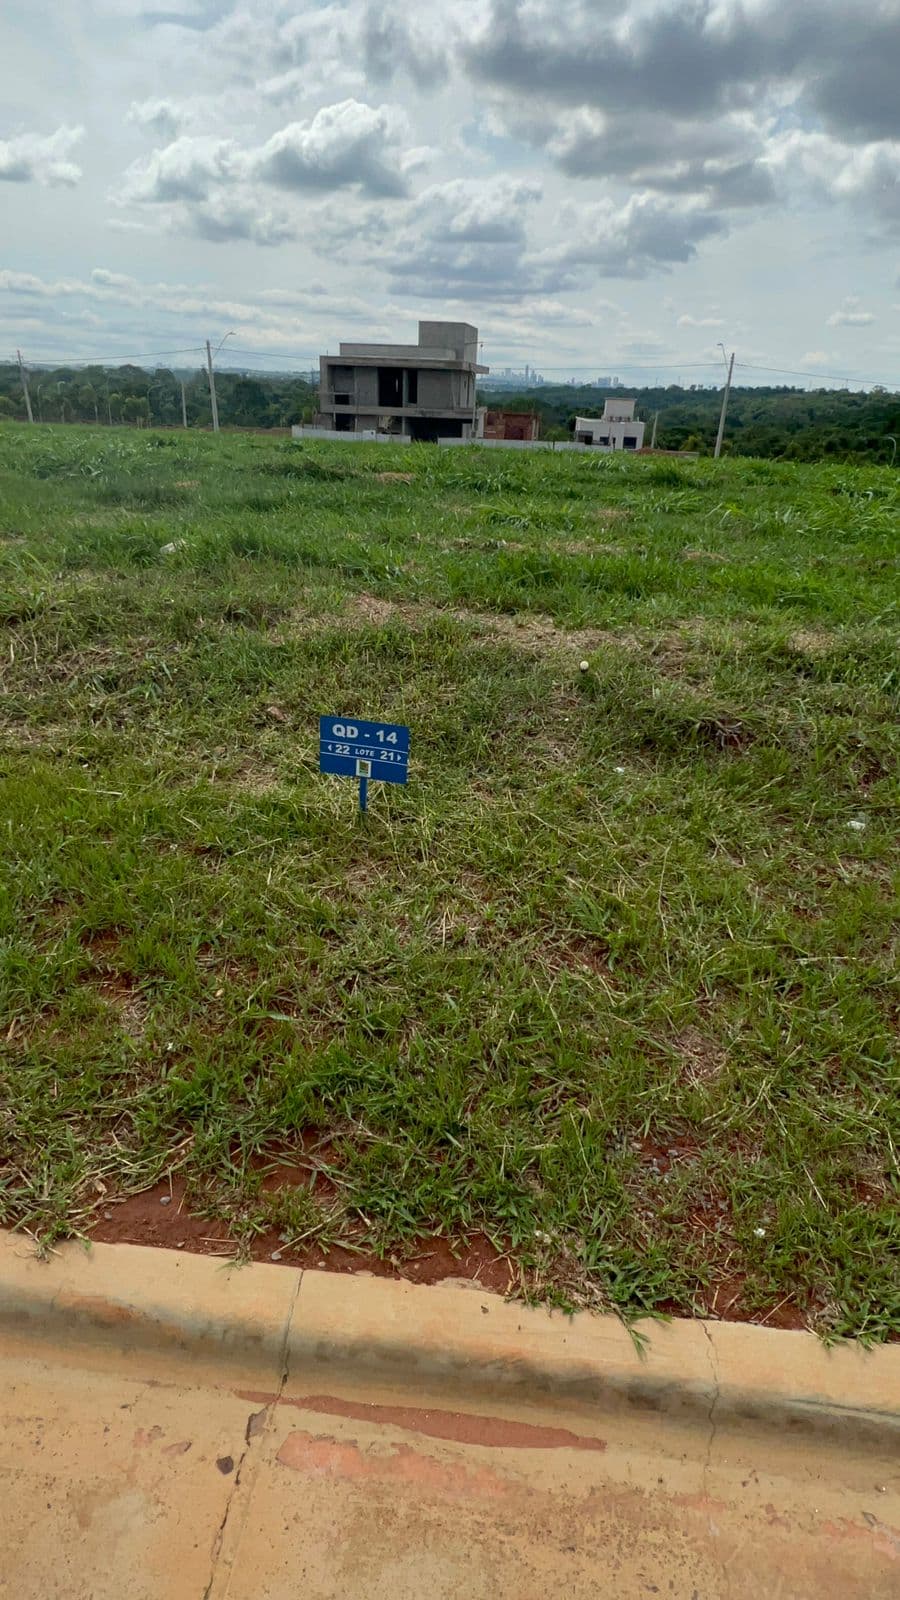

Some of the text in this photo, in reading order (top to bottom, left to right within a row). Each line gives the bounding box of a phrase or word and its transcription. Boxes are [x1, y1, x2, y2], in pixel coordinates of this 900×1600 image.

[332, 724, 359, 738] QD
[376, 730, 398, 744] 14
[335, 744, 394, 761] 22 LOTE 21
